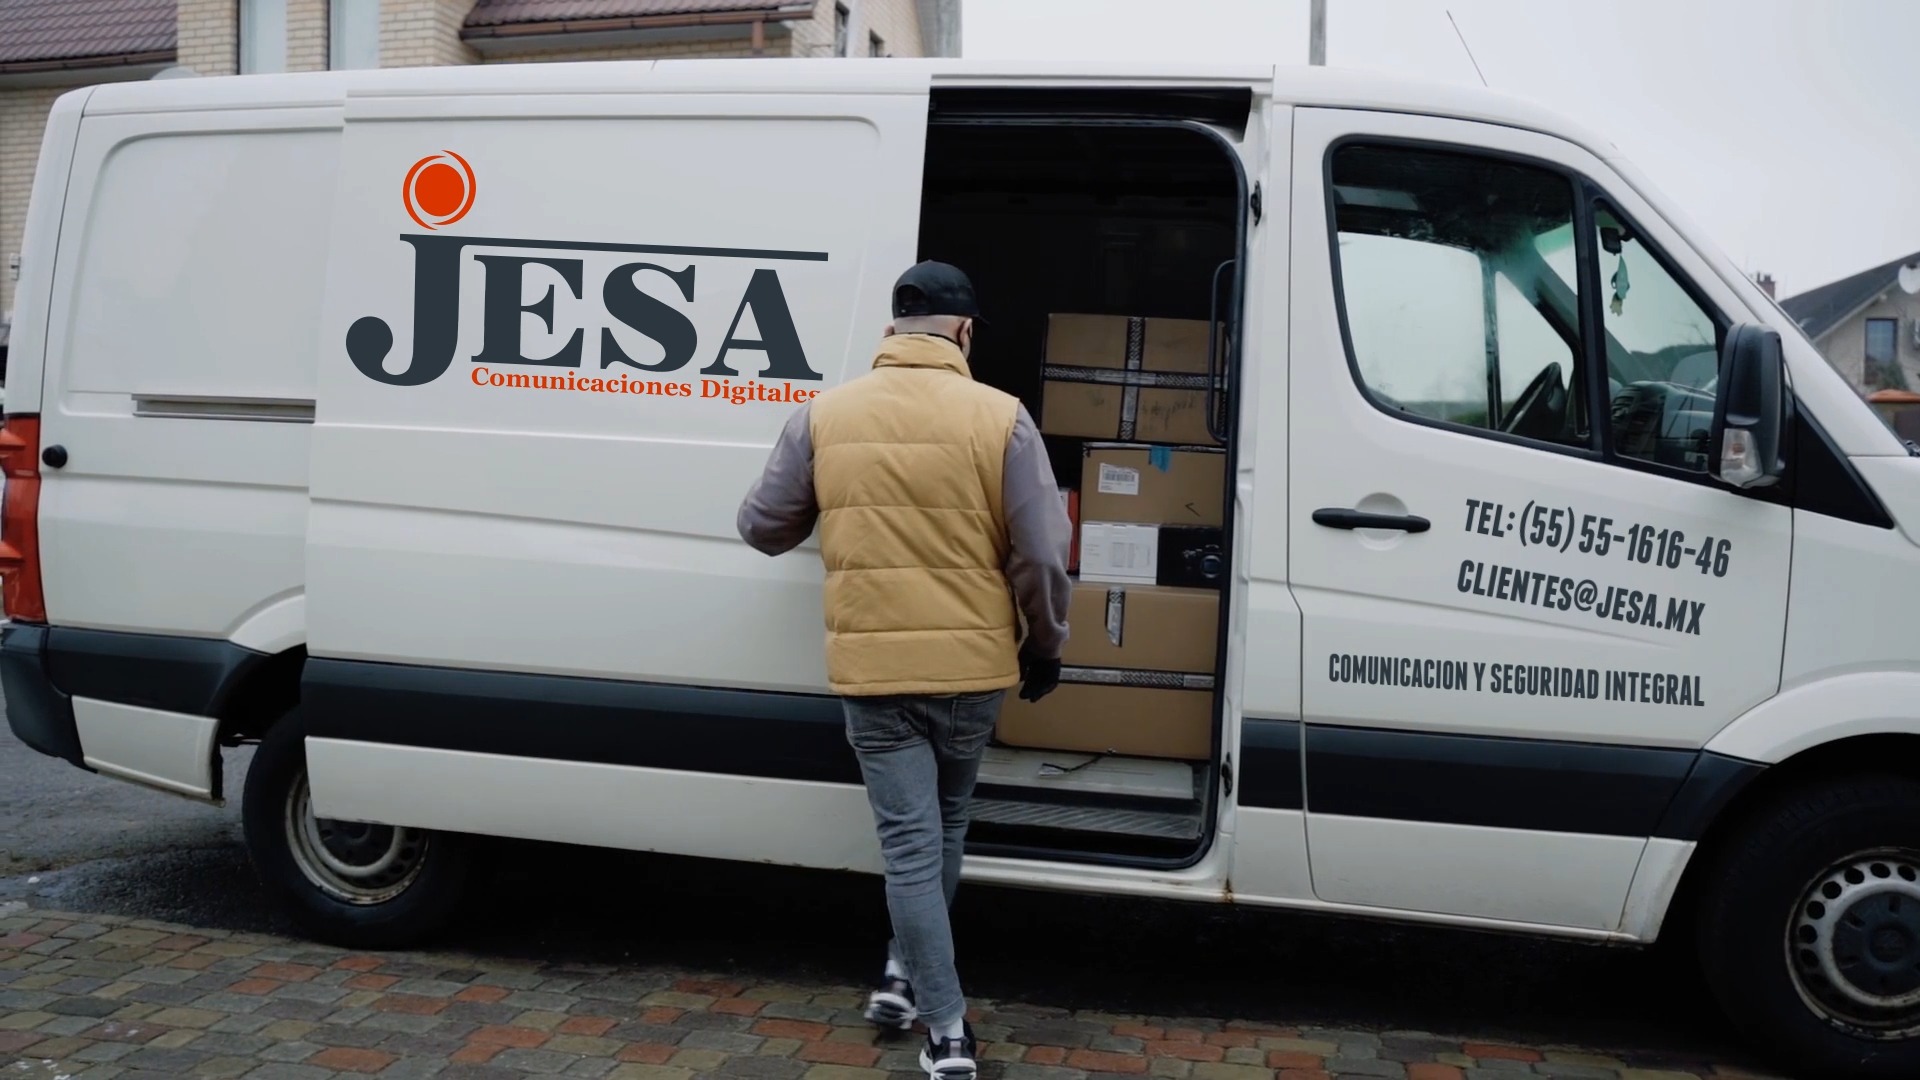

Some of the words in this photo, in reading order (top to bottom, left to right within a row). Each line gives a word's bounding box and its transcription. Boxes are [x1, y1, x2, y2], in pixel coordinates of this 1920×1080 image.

[346, 234, 828, 386] JESA
[471, 367, 692, 397] Comunicaciones
[1578, 514, 1732, 578] 55-1616-46
[1457, 559, 1706, 636] CLIENTES@JESA.MX
[1328, 653, 1468, 691] COMUNICACION
[1473, 662, 1486, 692] Y
[1490, 663, 1600, 700] SEGURIDAD
[1605, 670, 1705, 707] INTEGRAL
